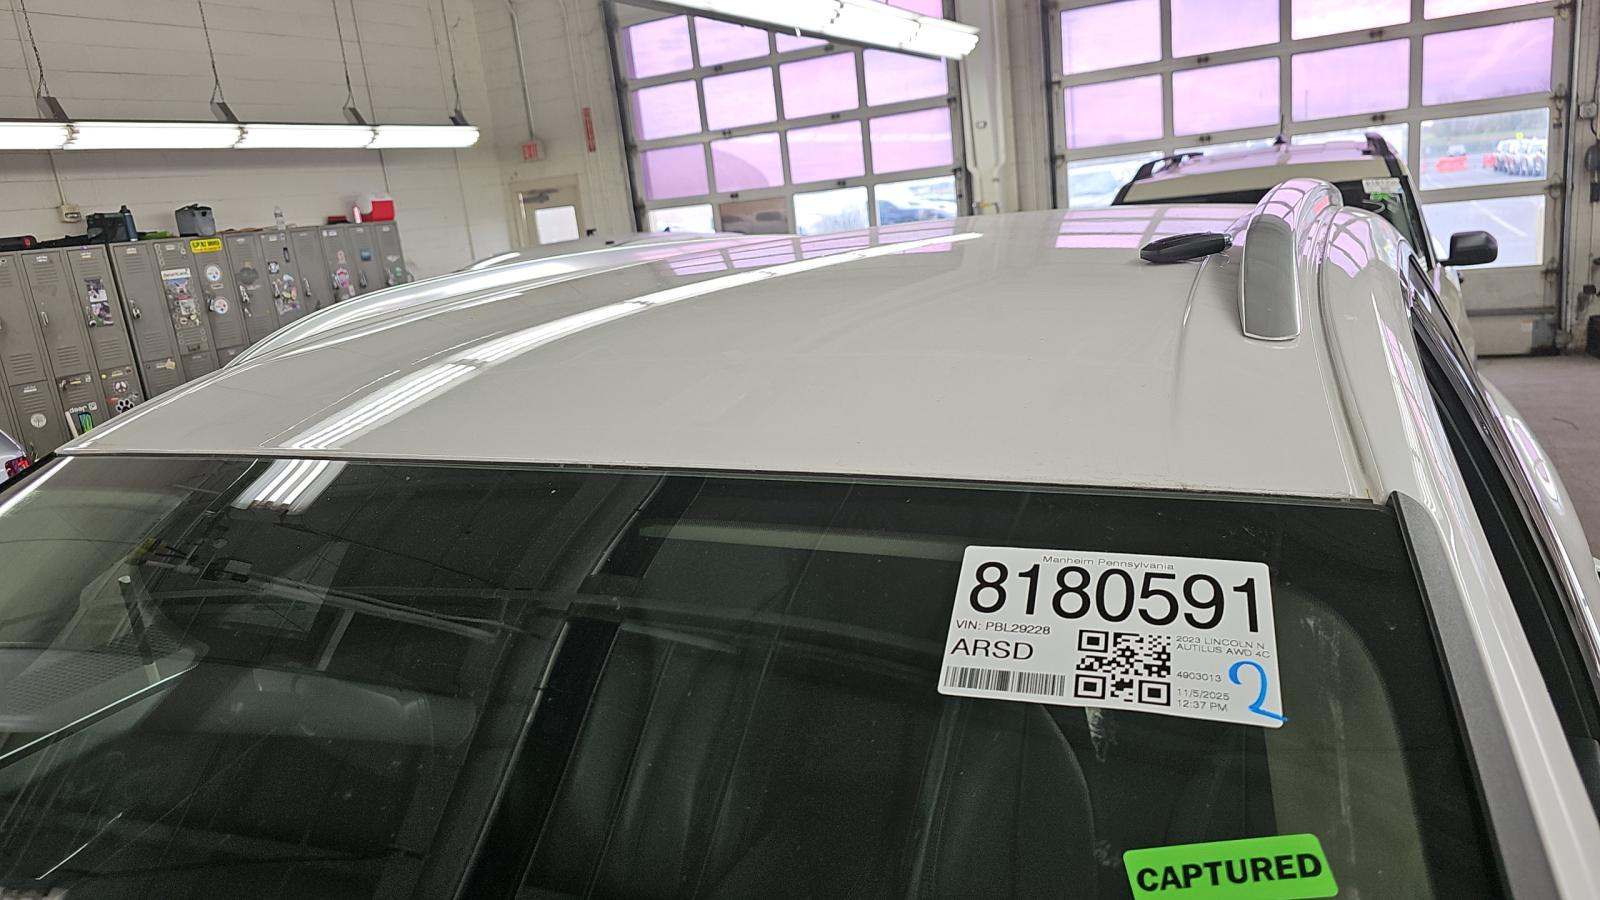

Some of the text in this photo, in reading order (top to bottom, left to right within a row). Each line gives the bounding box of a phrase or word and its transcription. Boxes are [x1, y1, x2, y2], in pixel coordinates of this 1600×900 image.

[1042, 555, 1174, 570] Manheim Pennsylvania
[969, 561, 1259, 633] 8180591
[956, 619, 1051, 635] VIN: PBL29228
[951, 638, 1034, 660] ARSD
[1176, 635, 1265, 650] 2023 LINCOLN N
[1176, 643, 1271, 658] AUTILUS AWD 4C
[1176, 671, 1222, 682] 4903013
[1177, 688, 1230, 701] 11/5/2025
[1228, 660, 1287, 721] 2
[1177, 699, 1228, 712] 12:37 PM
[1136, 853, 1322, 892] CAPTURED
